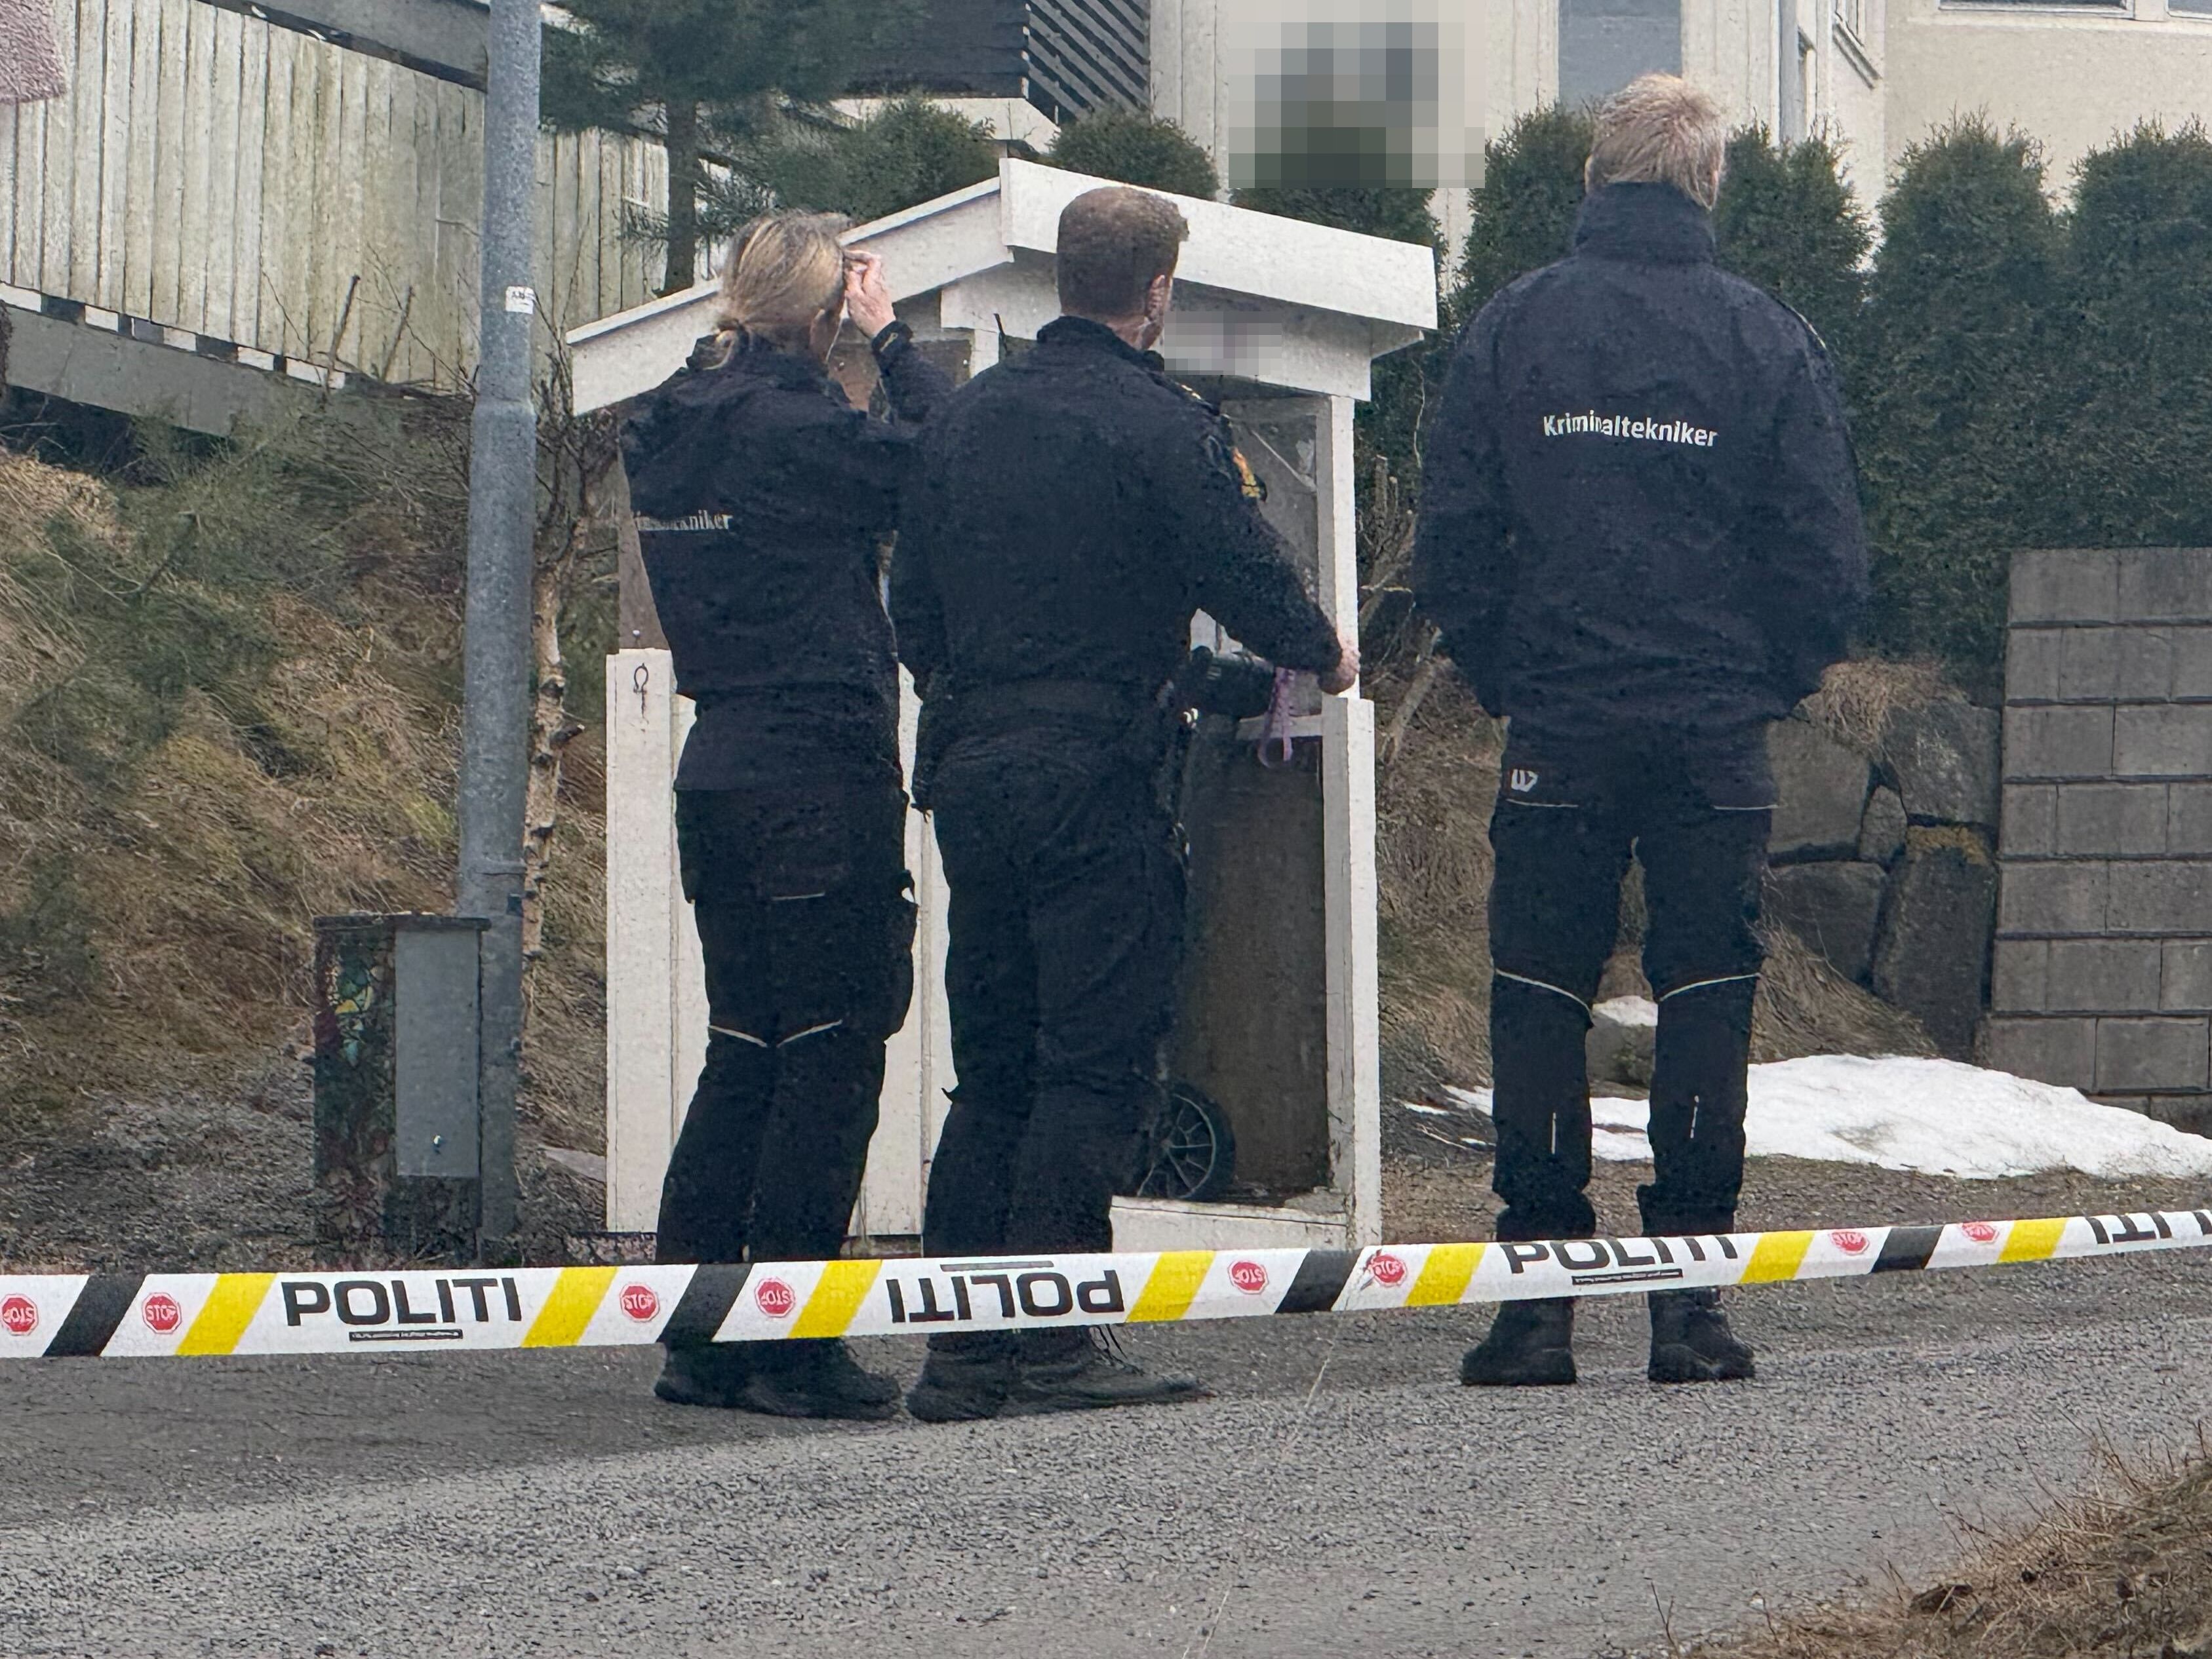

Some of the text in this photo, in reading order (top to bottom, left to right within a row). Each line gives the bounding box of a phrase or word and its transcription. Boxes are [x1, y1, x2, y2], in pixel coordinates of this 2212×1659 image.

[1543, 409, 1719, 446] Kriminaltekniker
[146, 1304, 177, 1322] STOP
[281, 1277, 522, 1327] POLITI
[623, 1294, 654, 1310] STOP
[886, 1270, 1125, 1323] POLITI
